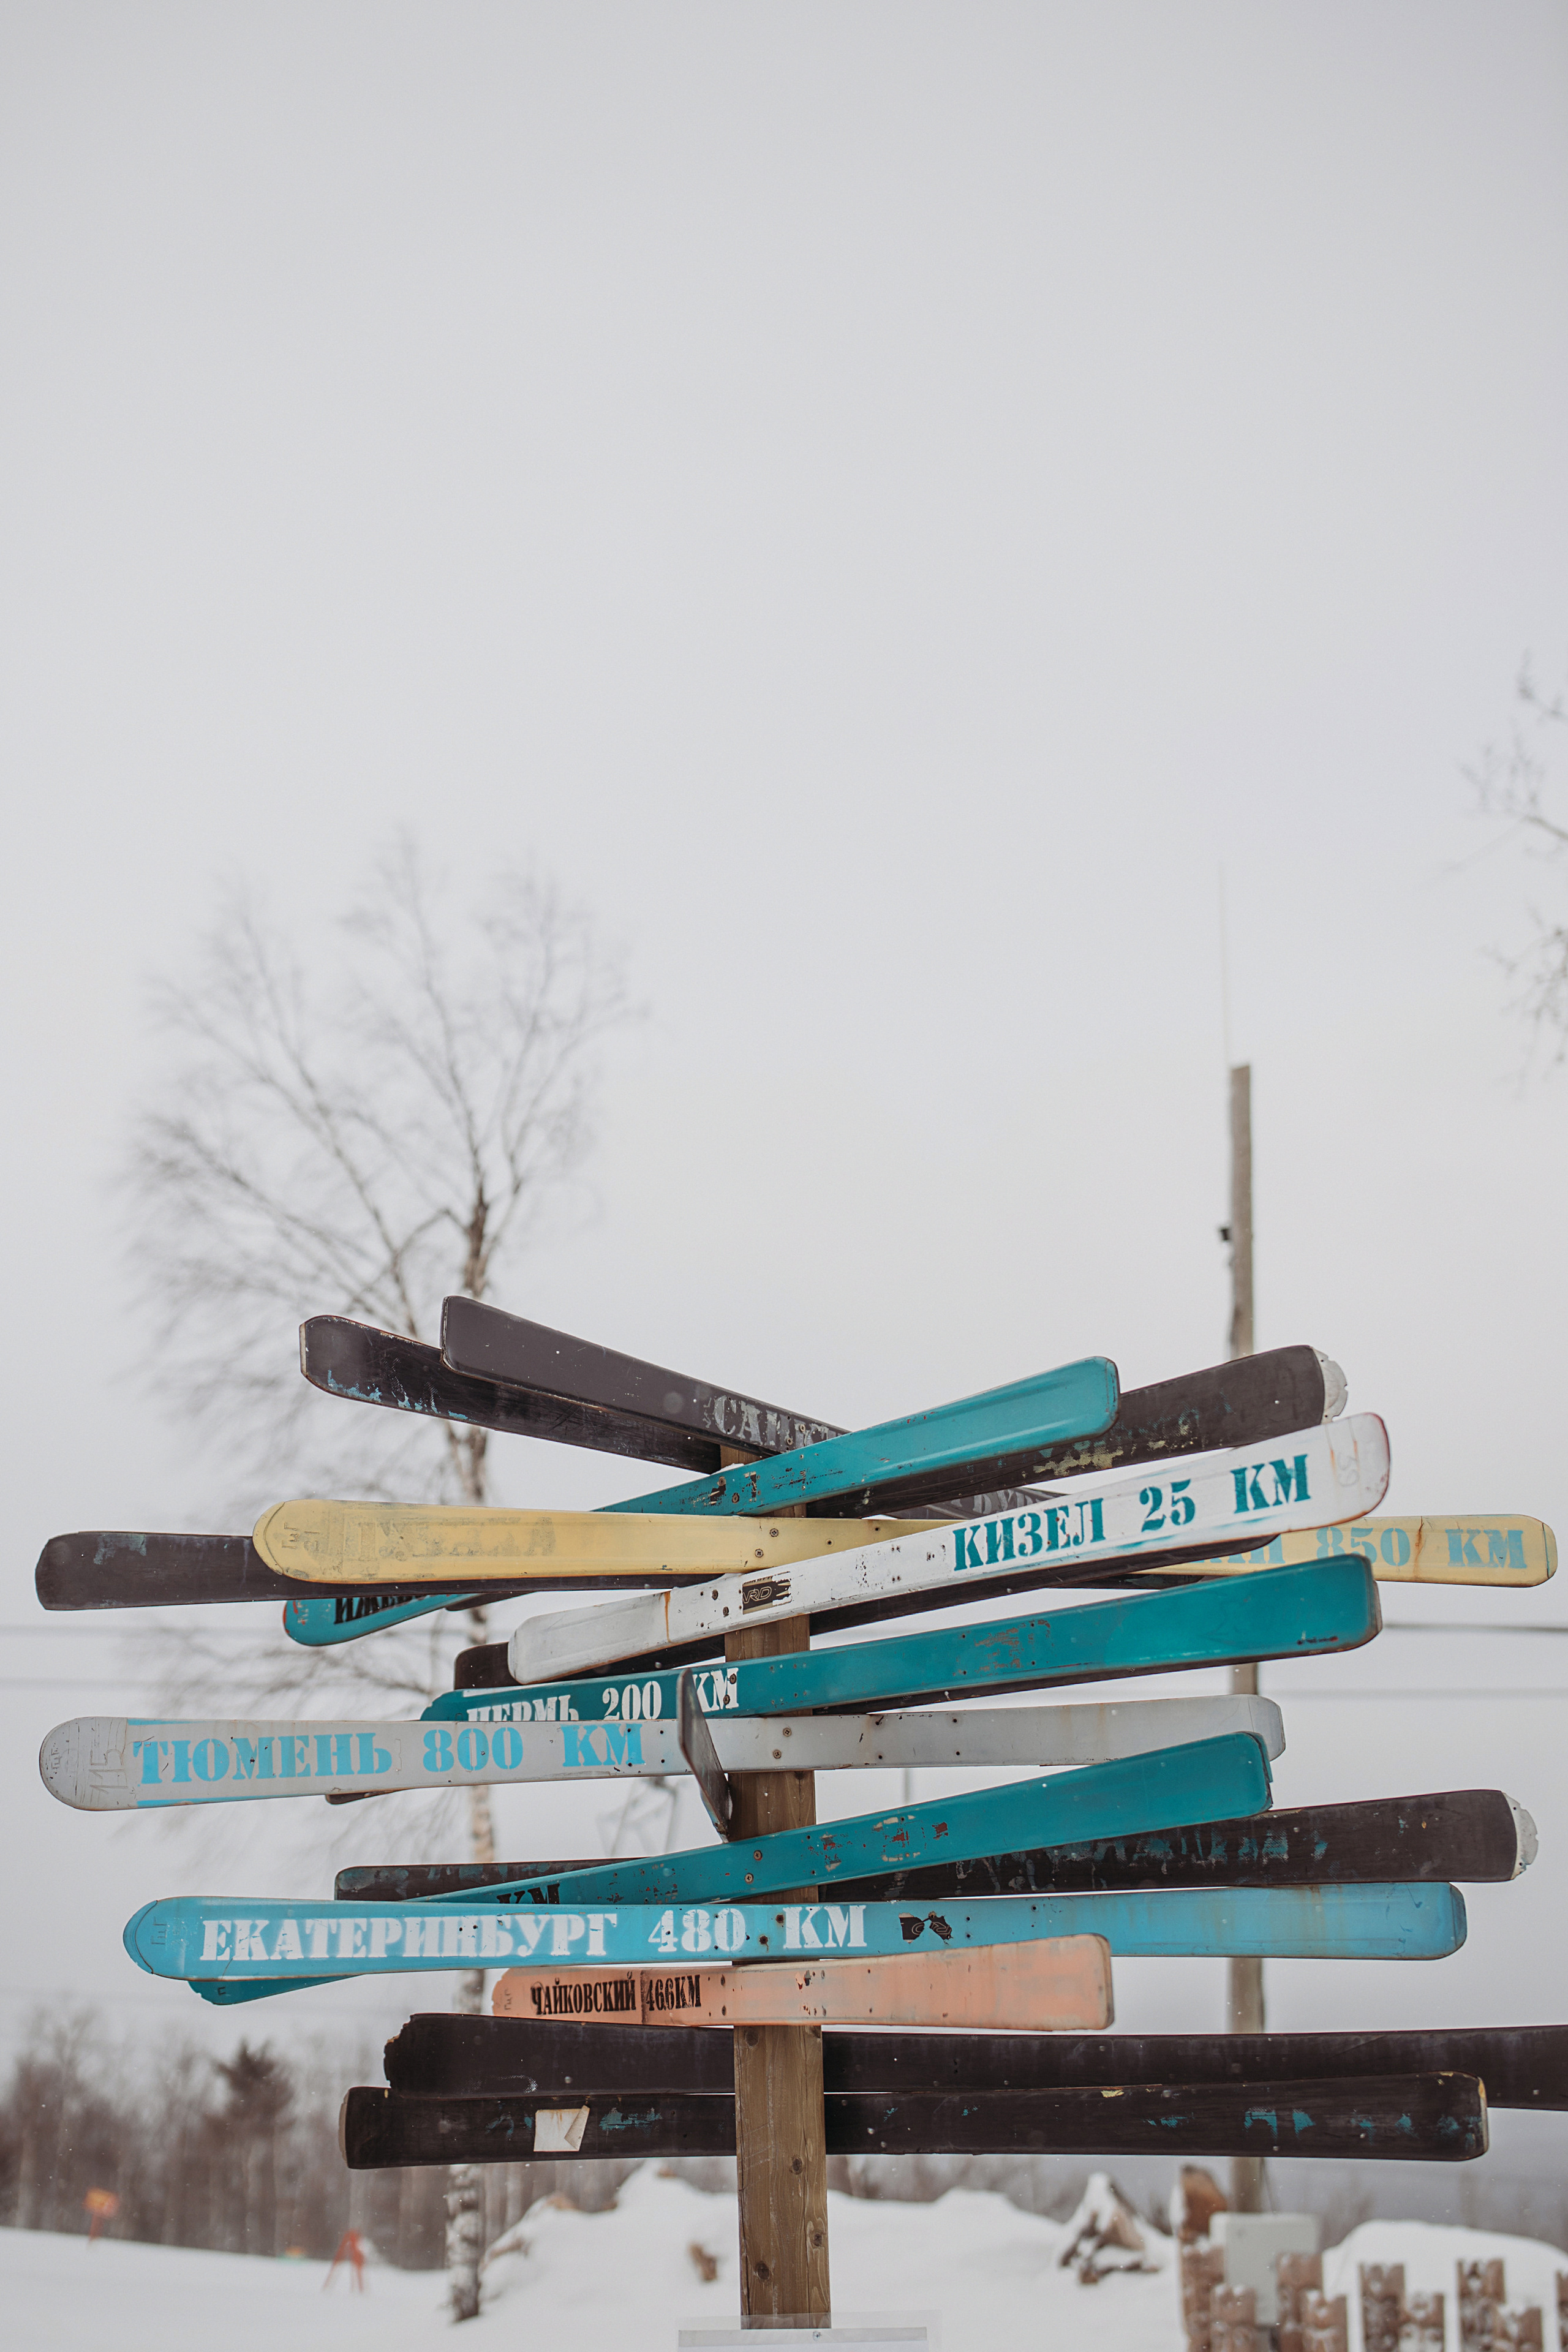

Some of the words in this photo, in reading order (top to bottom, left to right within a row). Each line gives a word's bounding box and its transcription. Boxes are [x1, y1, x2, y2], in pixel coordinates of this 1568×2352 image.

[952, 1498, 1106, 1571] КИЗЕЛ
[1139, 1478, 1196, 1532] 25
[1230, 1453, 1311, 1514] КМ
[1316, 1526, 1411, 1567] 850
[1445, 1528, 1528, 1569] КМ
[601, 1680, 662, 1721] 200
[132, 1732, 393, 1785] ТЮМЕНЬ
[422, 1727, 524, 1773] 800
[560, 1722, 646, 1768] КМ
[199, 1913, 617, 1961] ЕКАТЕРИНБУРГ
[647, 1907, 746, 1953] 480
[782, 1904, 868, 1950] КМ
[530, 1970, 636, 2016] ЧАЙКОВСКИЙ
